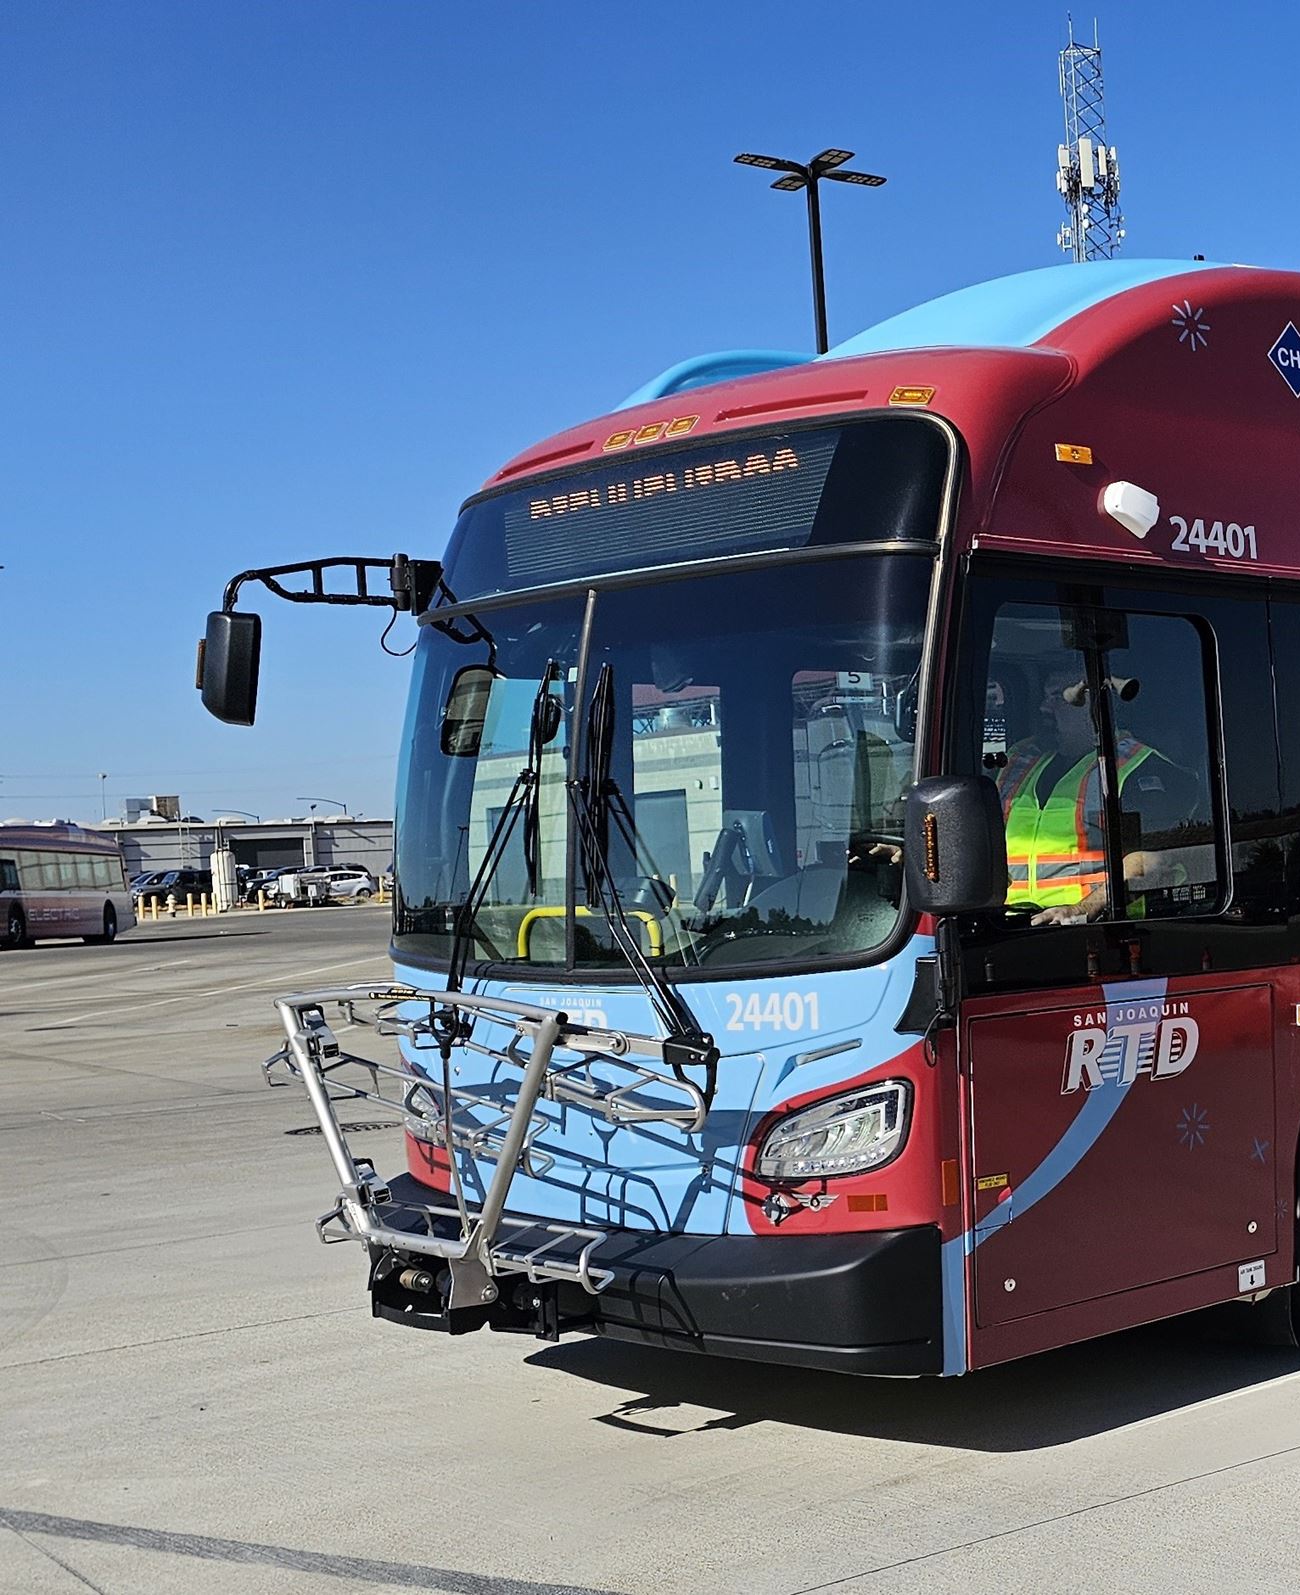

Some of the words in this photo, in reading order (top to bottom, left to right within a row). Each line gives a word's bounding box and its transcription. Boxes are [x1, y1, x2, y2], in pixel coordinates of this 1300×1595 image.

[1169, 515, 1257, 559] 24401
[540, 997, 557, 1006] SAN
[560, 998, 602, 1008] JOAQUIN
[725, 991, 819, 1031] 24401
[1074, 1012, 1106, 1027] SAN
[1116, 1002, 1189, 1022] JOAQUIN
[1061, 1017, 1199, 1095] RTD
